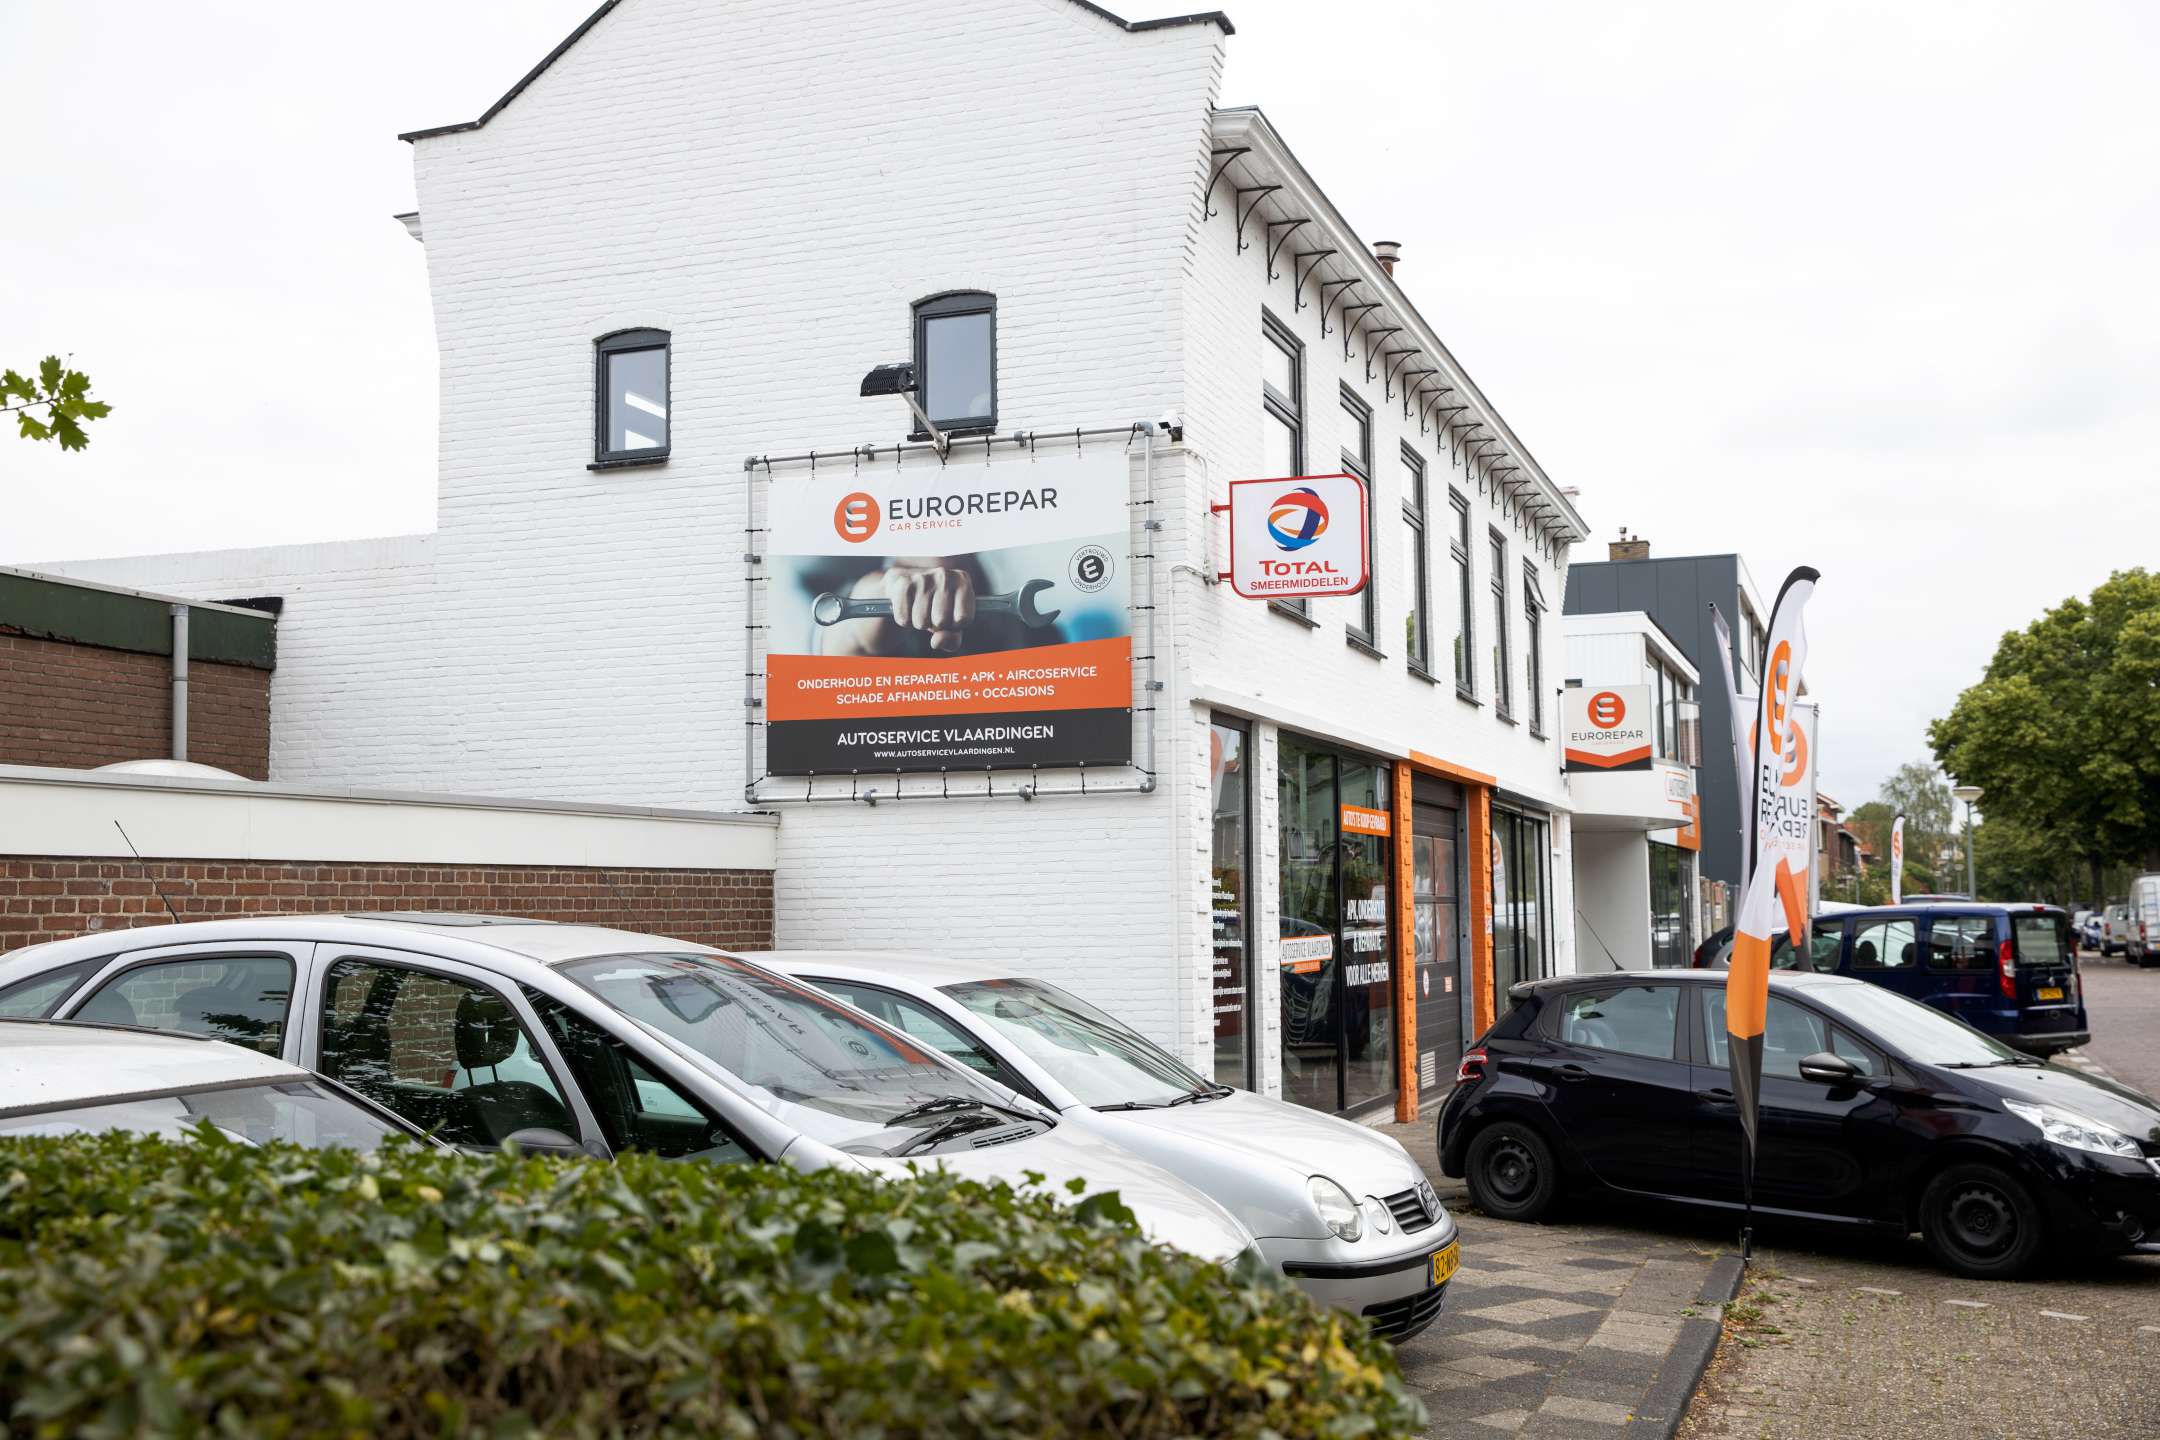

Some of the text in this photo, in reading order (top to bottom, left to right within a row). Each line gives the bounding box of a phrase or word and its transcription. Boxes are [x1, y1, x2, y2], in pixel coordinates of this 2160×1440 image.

[889, 487, 1058, 520] EUROREPAR
[889, 519, 963, 532] CAR SERVICE
[1258, 560, 1339, 576] TOTAL
[1250, 577, 1348, 590] SMEERMIDDELEN
[797, 666, 1097, 690] ONDERHOUD EN REPARATIE APK AIRCOSERVICE
[836, 685, 1055, 705] SCHADE AFHANDELING OCCASIONS
[837, 725, 1054, 746] AUTOSERVICE VLAARDINGEN
[1571, 730, 1644, 741] EUROREPAR
[873, 747, 1016, 758] WWW.AUTOSERVICEVLAARDINGEN.NL
[1345, 965, 1360, 987] VOOR
